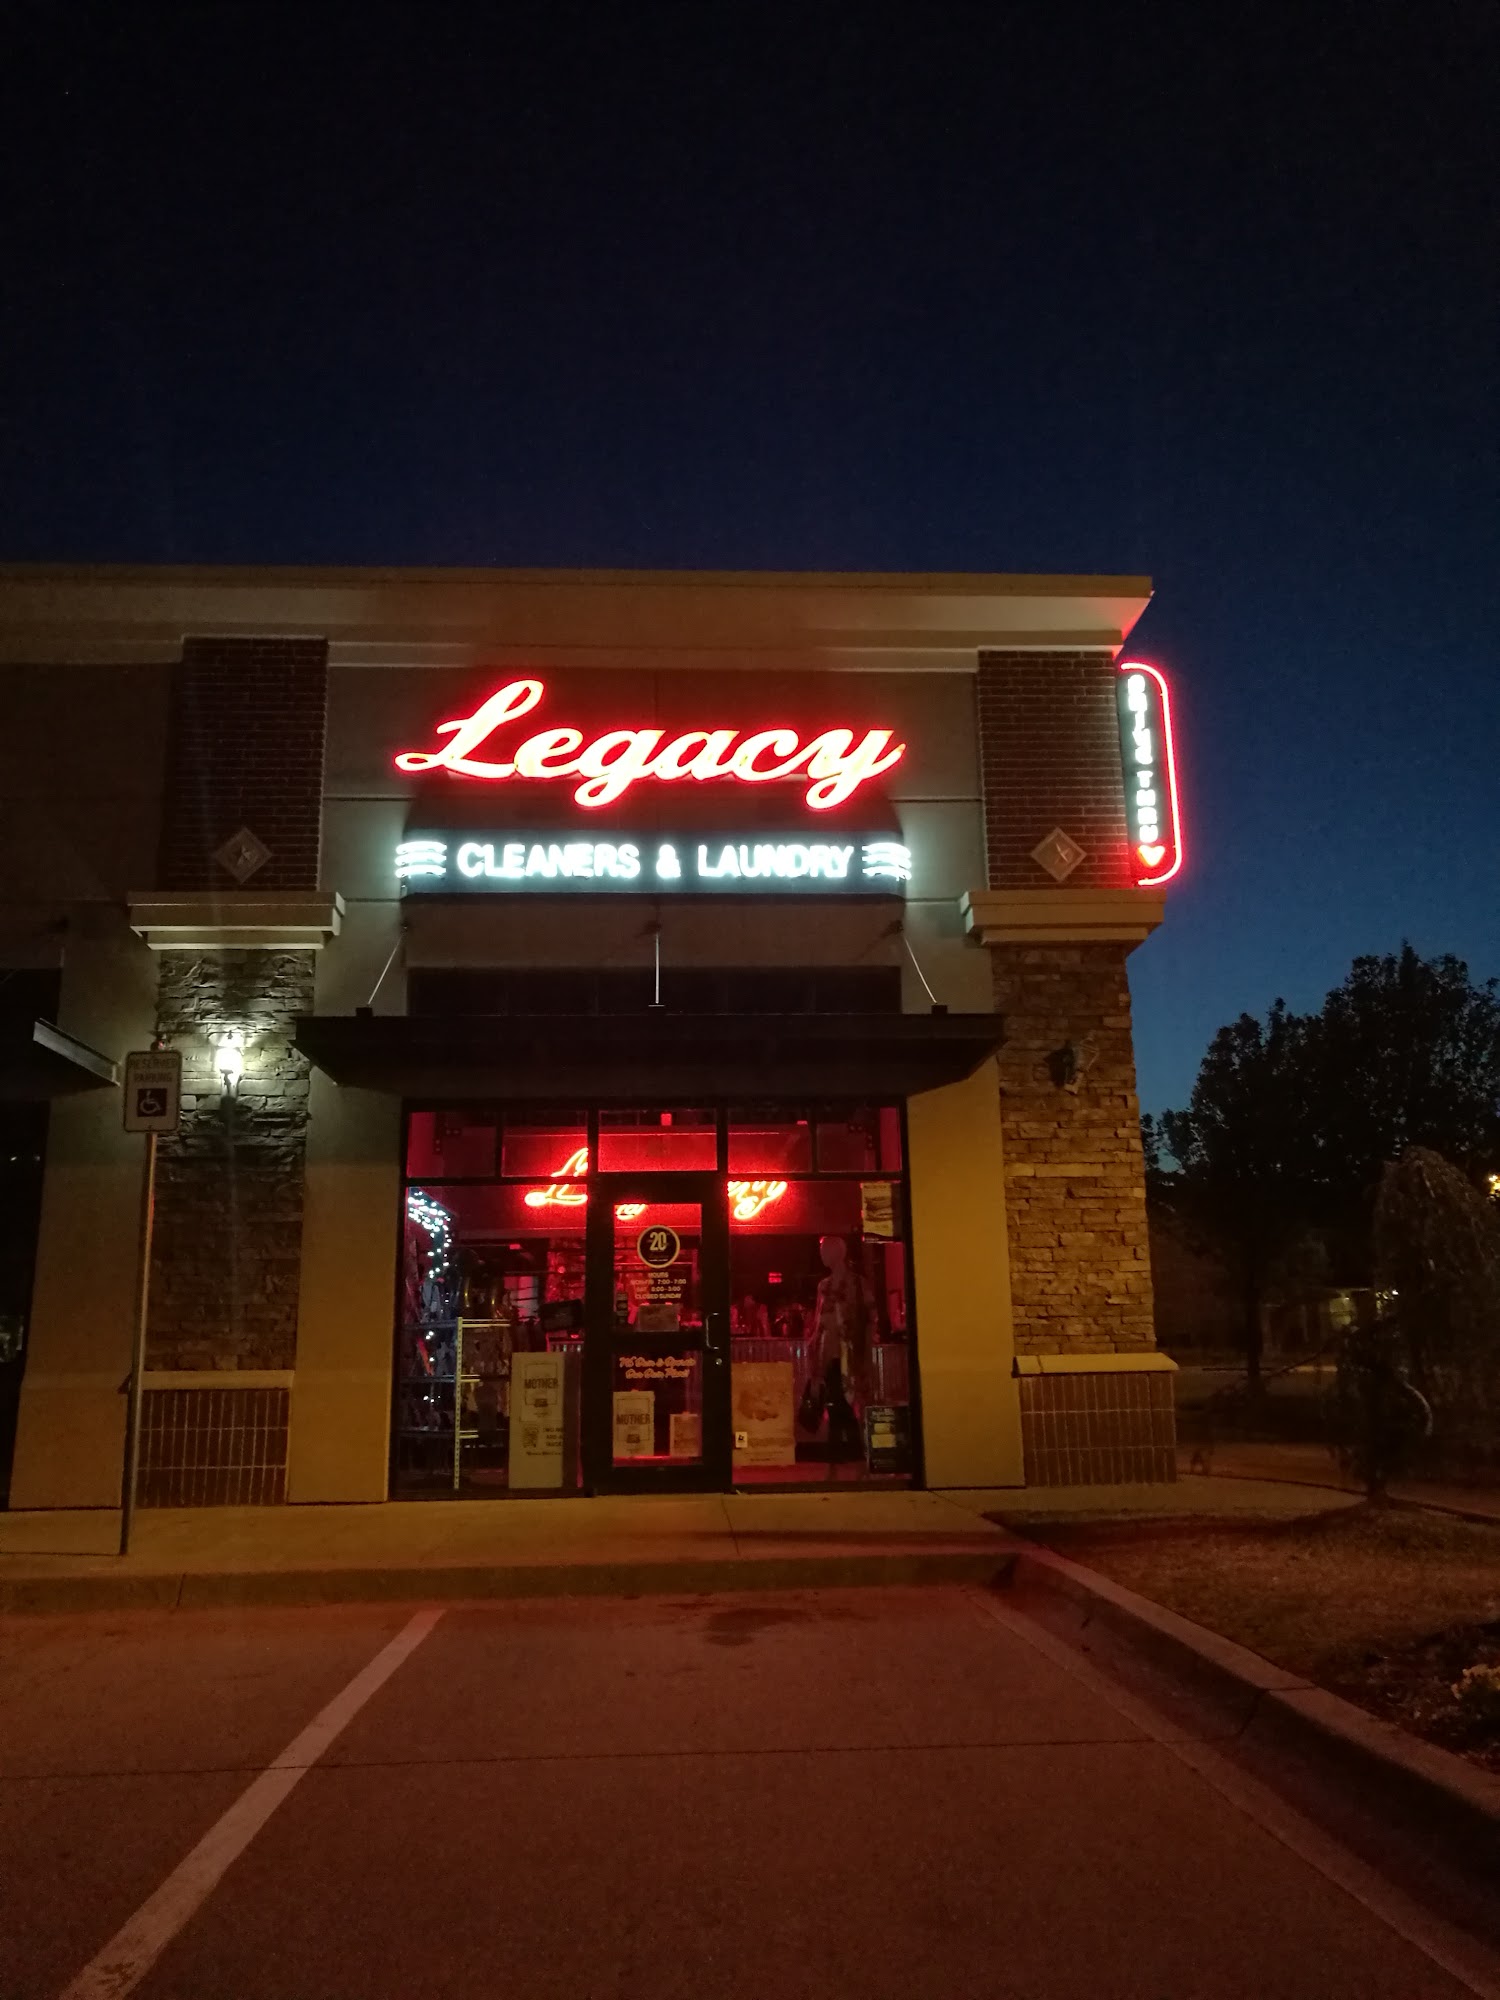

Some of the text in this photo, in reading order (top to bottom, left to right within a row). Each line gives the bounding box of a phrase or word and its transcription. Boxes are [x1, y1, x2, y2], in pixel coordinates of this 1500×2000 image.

[394, 679, 906, 810] Legacy
[456, 843, 855, 881] CLEANERS & LAUNDRY
[649, 1231, 667, 1250] 20
[524, 1378, 559, 1389] MOTHER
[616, 1414, 651, 1425] MOTHER
